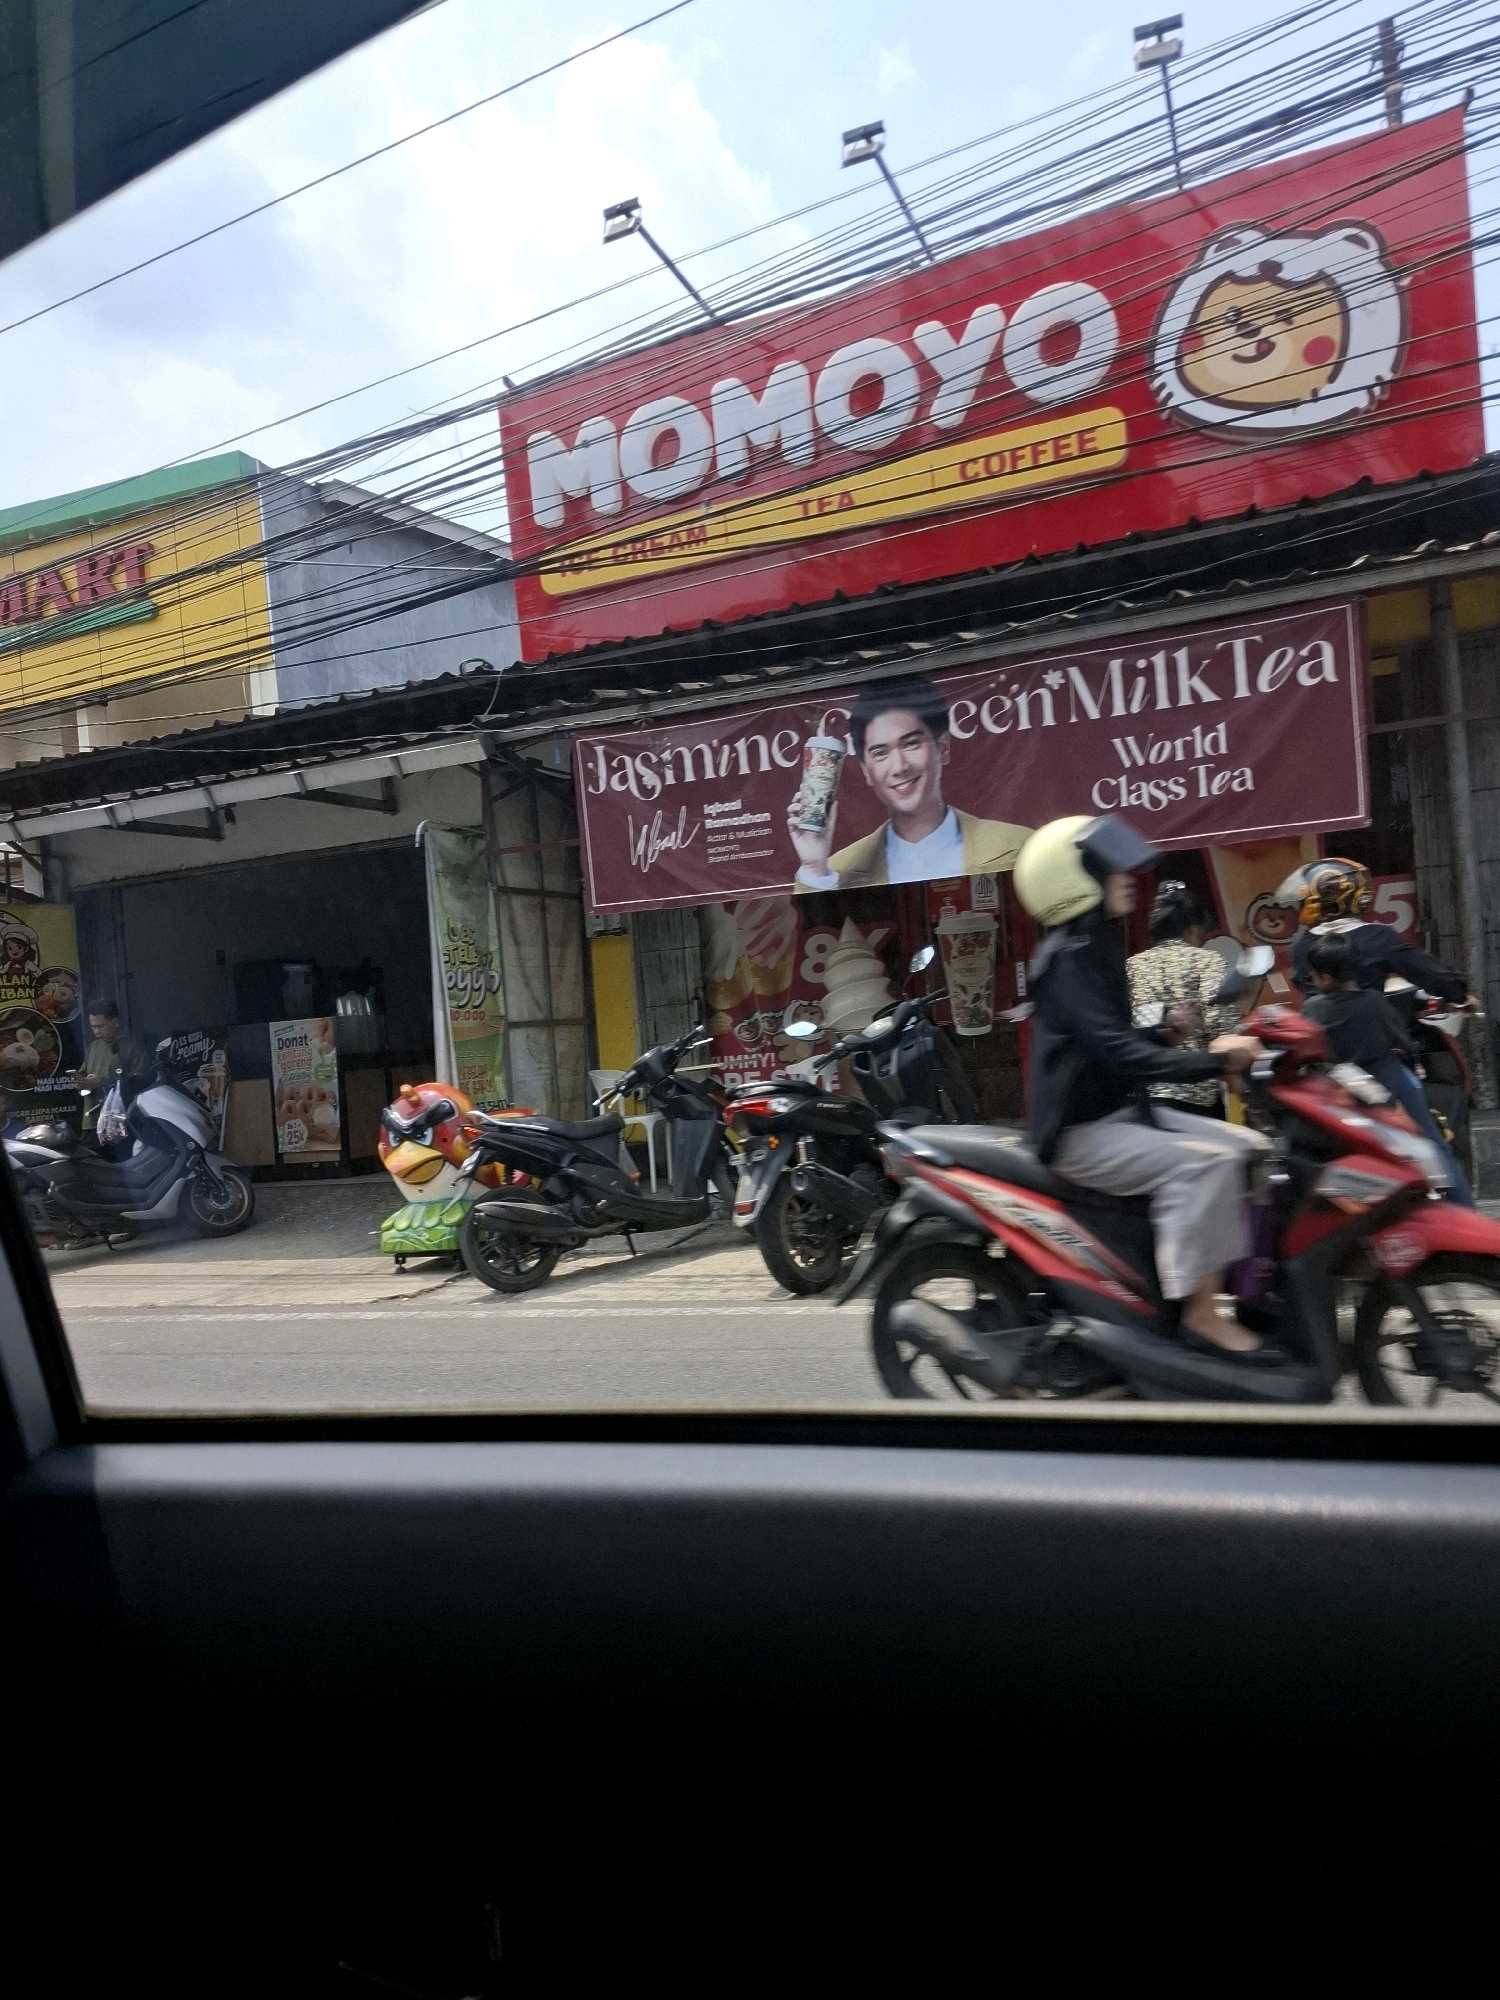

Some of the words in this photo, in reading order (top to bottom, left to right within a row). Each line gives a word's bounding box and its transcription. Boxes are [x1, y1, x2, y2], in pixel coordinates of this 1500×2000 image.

[526, 280, 1120, 529] MOMOYO
[958, 428, 1100, 482] COFFEE
[799, 487, 856, 517] TEA
[611, 524, 708, 563] CREAM
[587, 729, 801, 801] Jasmine
[1067, 646, 1223, 723] Milk
[1215, 635, 1340, 699] Tea
[1110, 721, 1229, 769] World
[1090, 770, 1188, 812] Class
[1187, 763, 1255, 798] Tea
[1374, 880, 1417, 933] 5
[169, 1037, 216, 1062] Creamy
[277, 1033, 309, 1051] Donat
